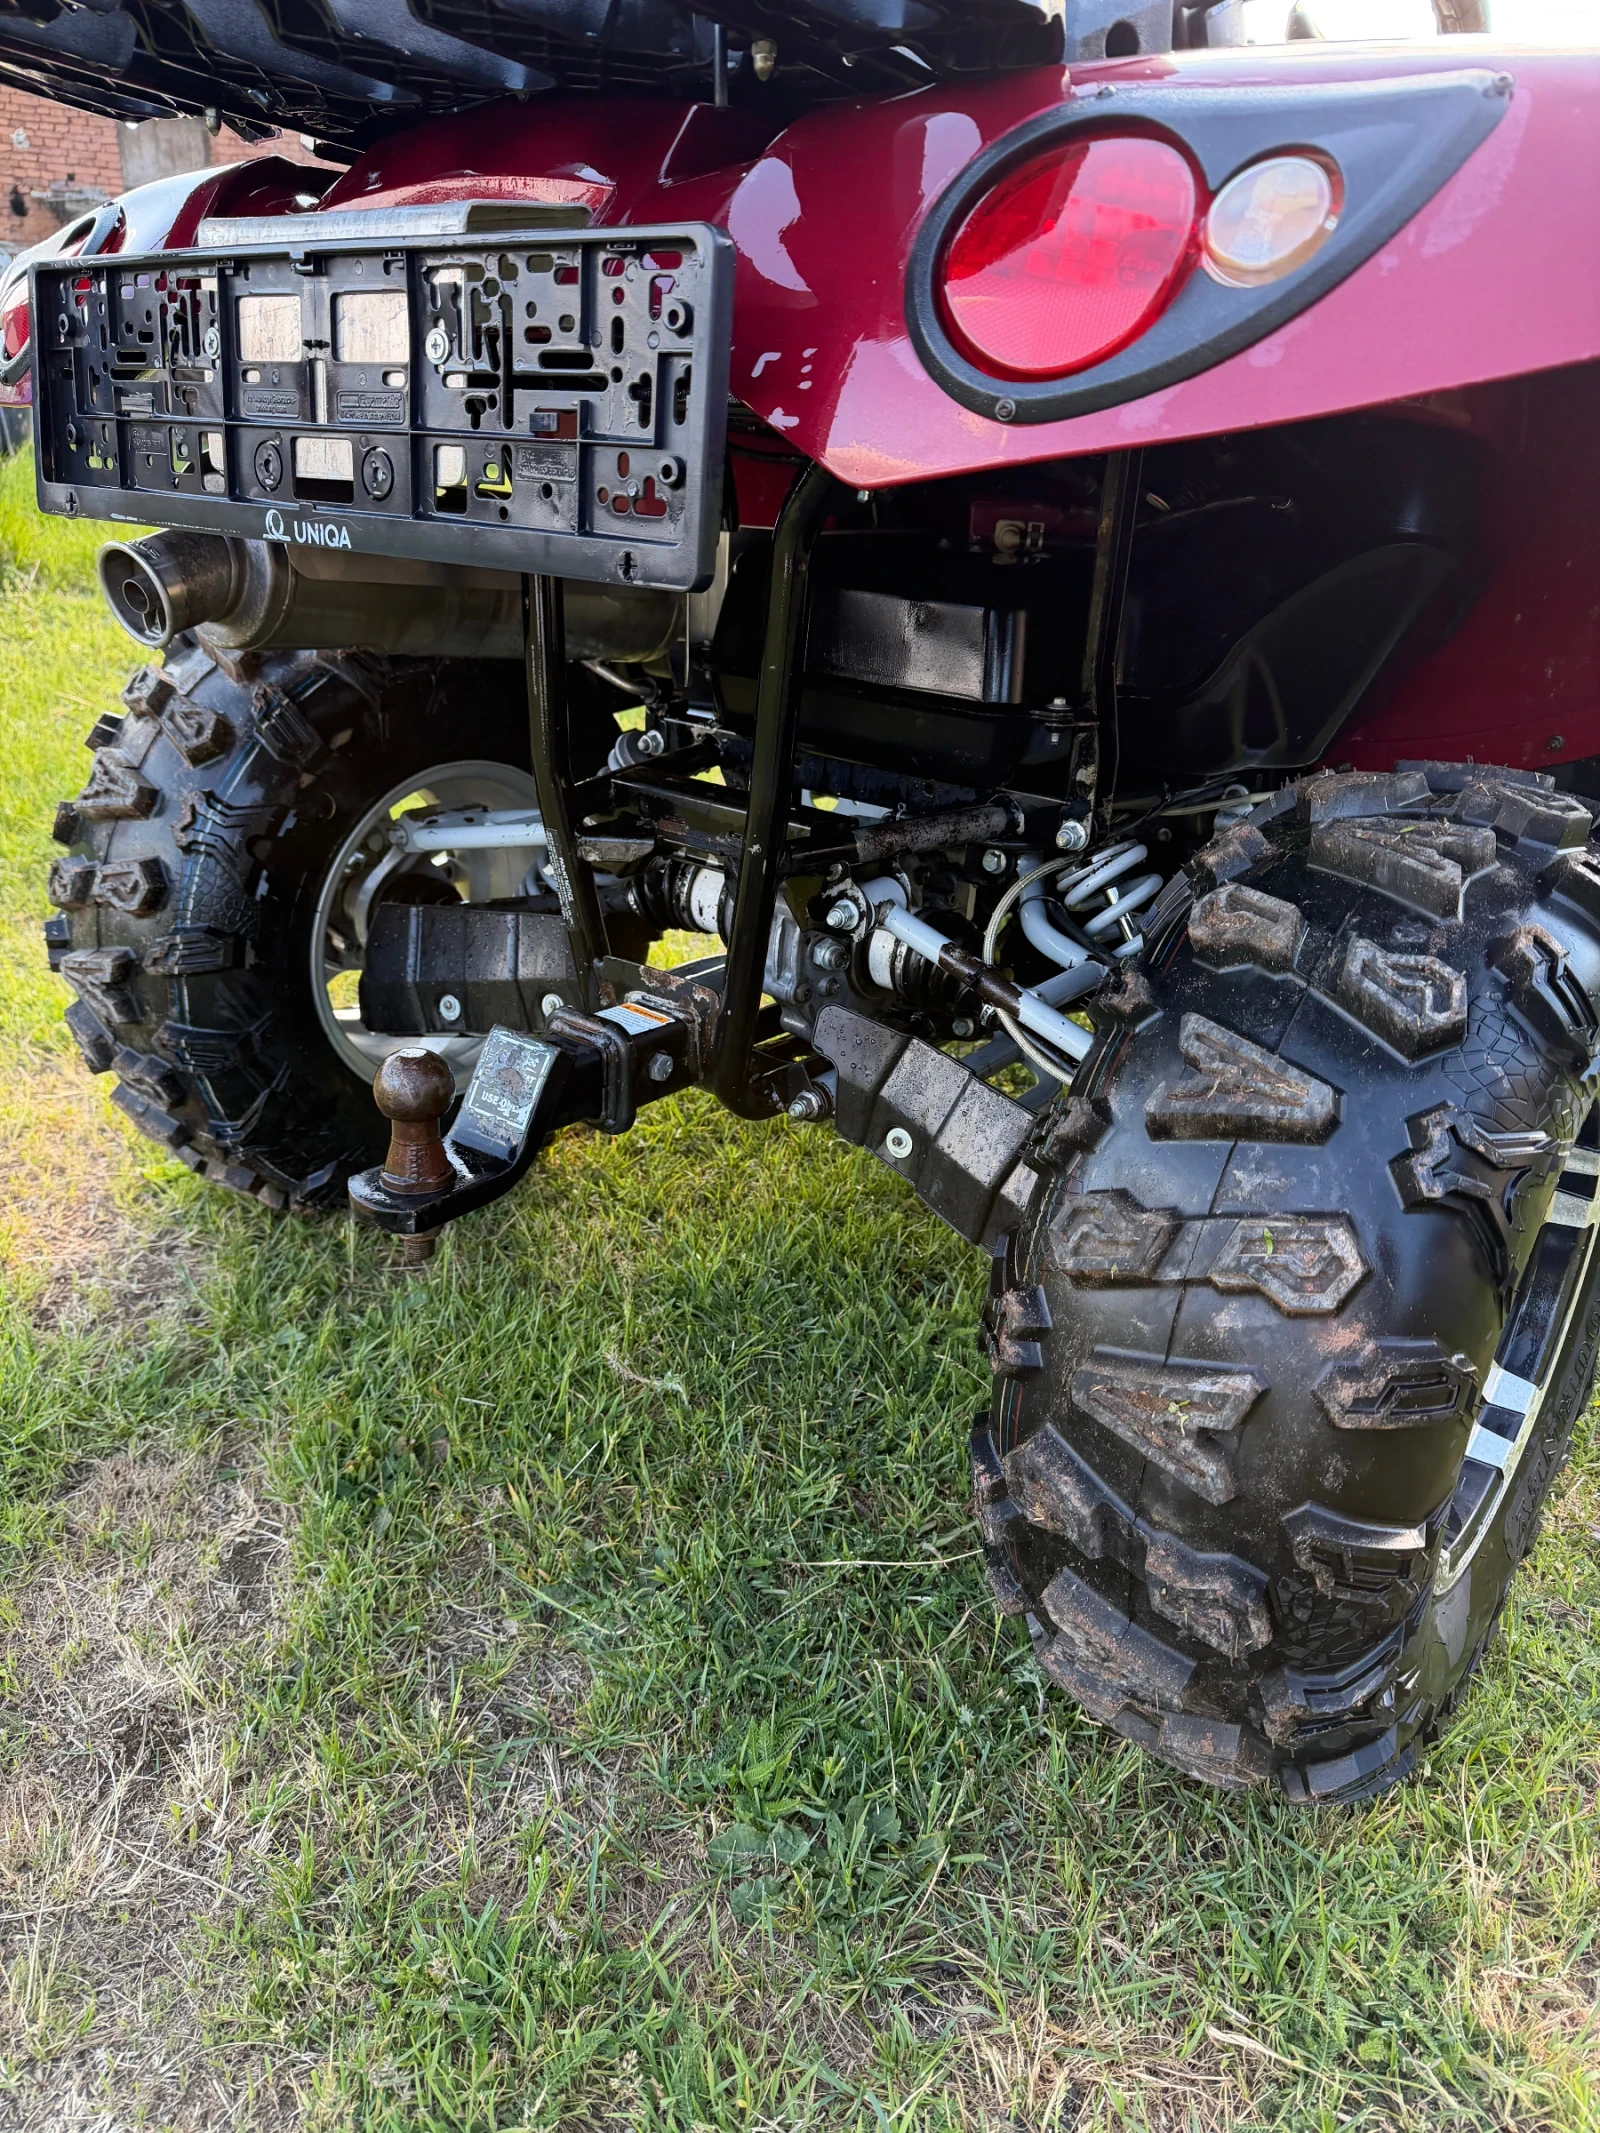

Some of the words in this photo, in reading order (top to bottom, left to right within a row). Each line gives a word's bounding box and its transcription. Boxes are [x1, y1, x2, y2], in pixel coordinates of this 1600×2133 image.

[293, 520, 352, 549] UNIQA
[564, 879, 574, 902] NOTICE
[481, 1090, 500, 1106] USE
[1514, 1298, 1600, 1545] OURNEY
